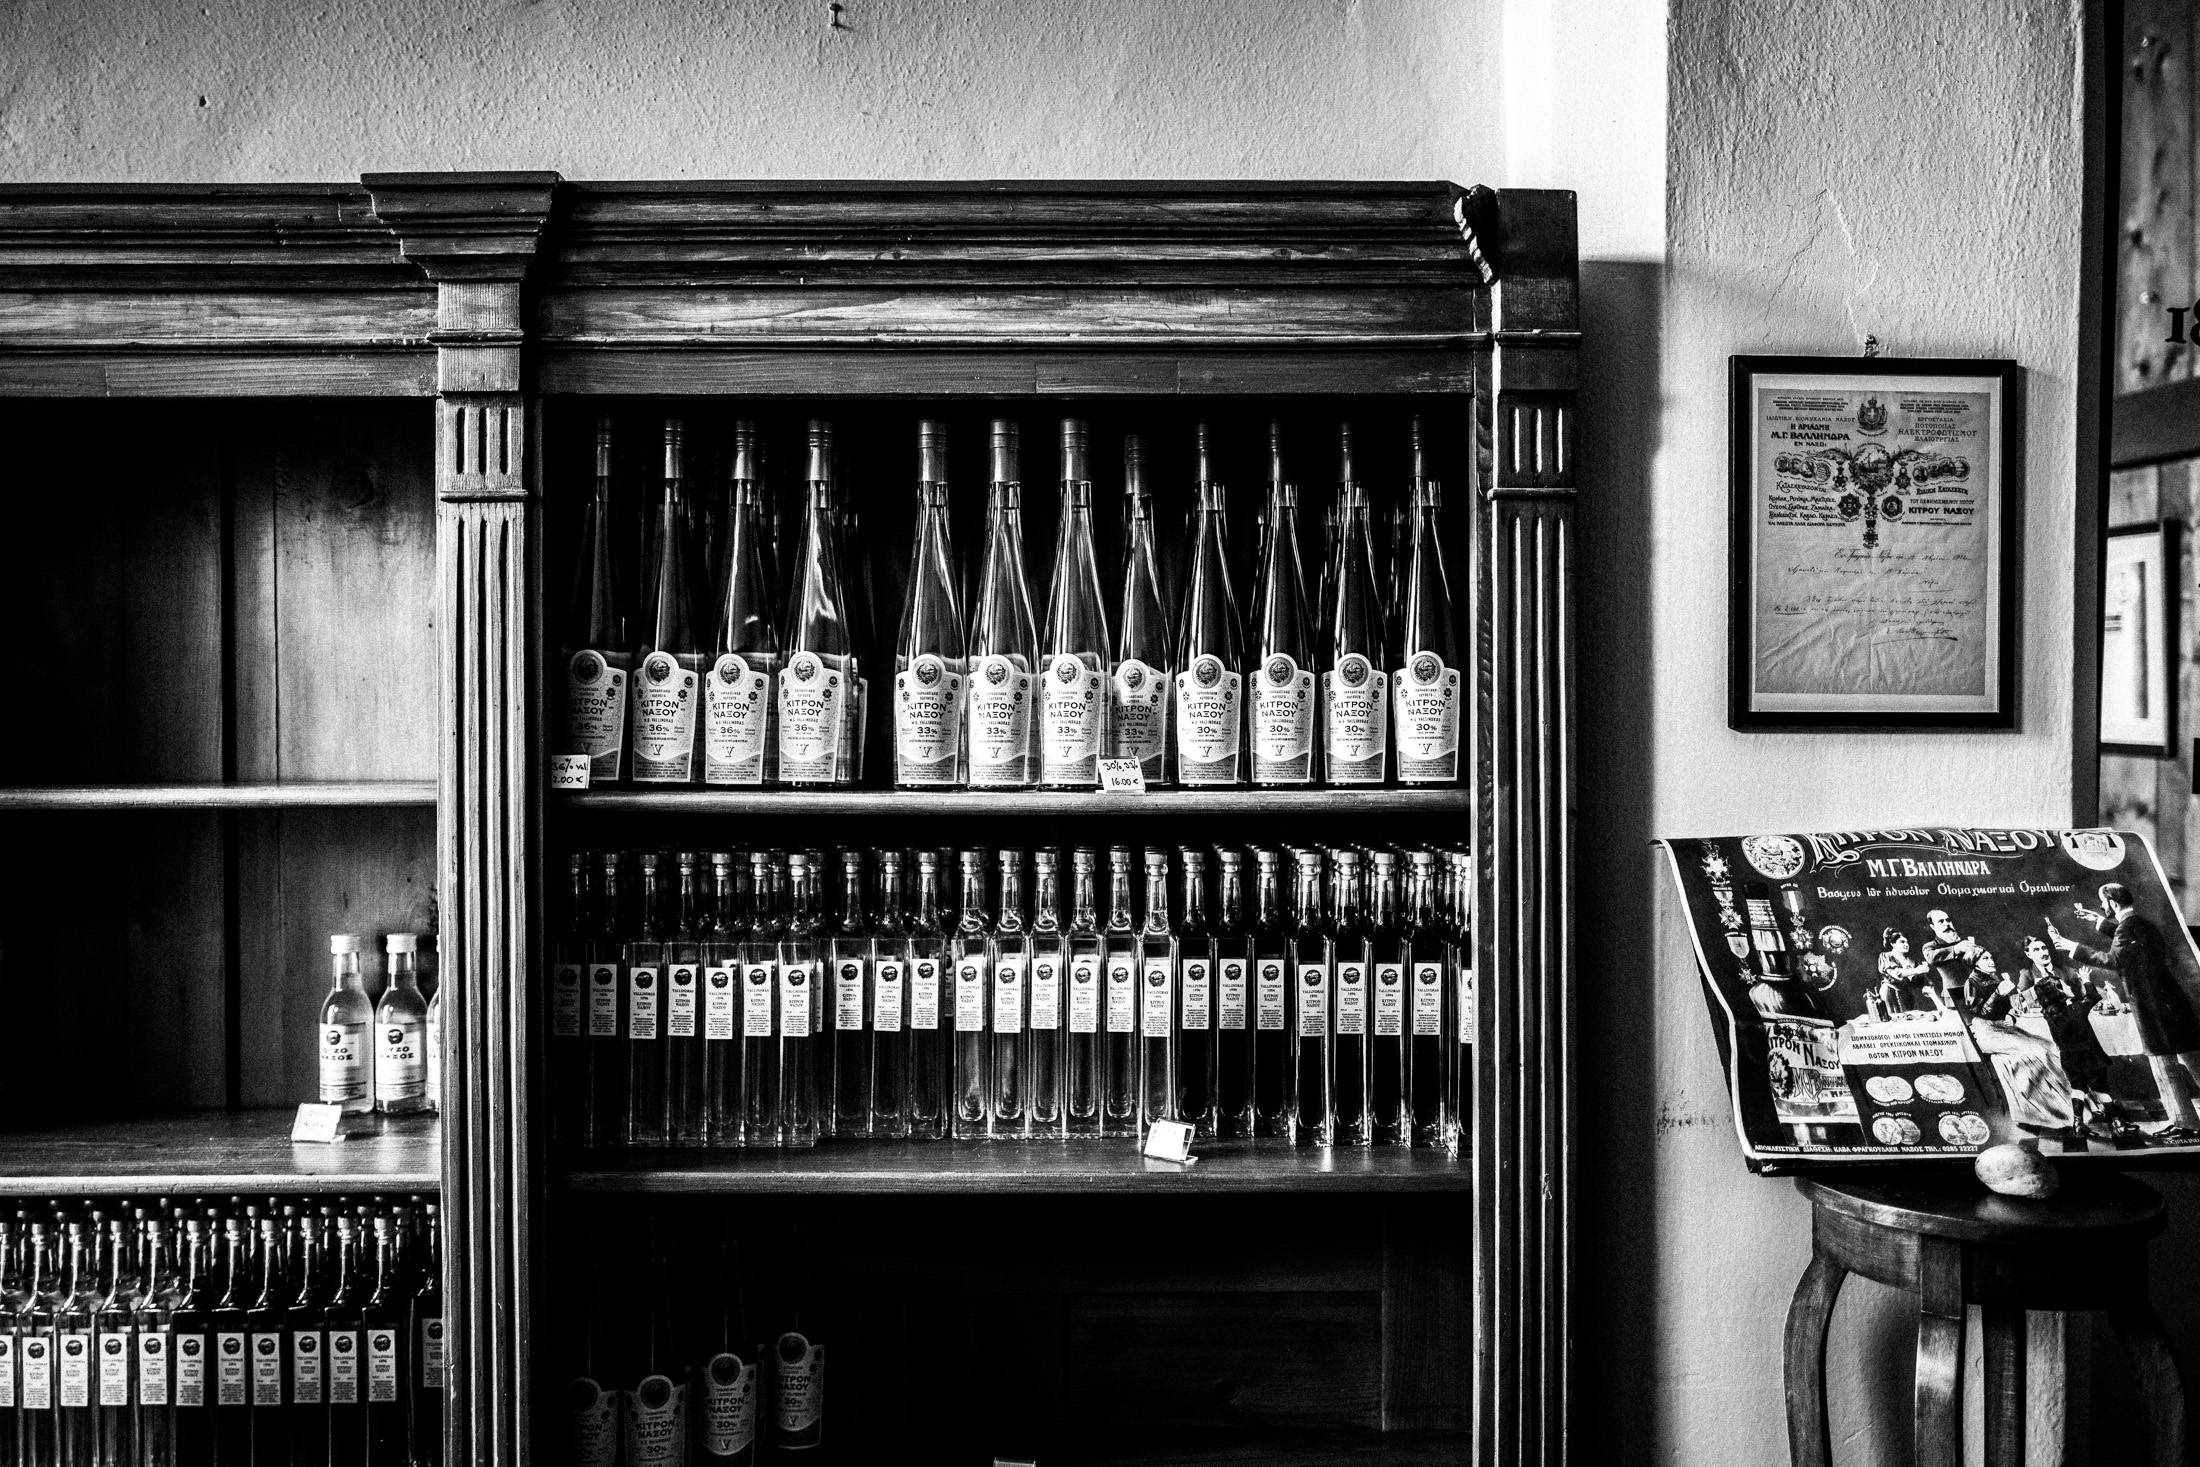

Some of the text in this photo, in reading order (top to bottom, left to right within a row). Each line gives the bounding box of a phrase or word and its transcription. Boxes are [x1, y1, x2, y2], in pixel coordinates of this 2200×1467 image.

[1797, 423, 1830, 431] ΑΡΙΑΔΝΗ
[1790, 431, 1851, 441] ΒΑΛΛΗΝΔΡΑ
[1943, 507, 1975, 515] ΝΑΞΟΥ
[640, 700, 680, 709] ΚΙΤΡΟΝ
[712, 702, 750, 711] ΚΙΤΡΟΝ
[786, 699, 825, 709] ΚΙΤΡΟΝ
[907, 702, 947, 711] ΚΙΤΡΟΝ
[977, 702, 1016, 711] ΚΙΤΡΟΝ
[1048, 701, 1087, 710] ΚΙΤΡΟΝ
[1187, 702, 1226, 711] ΚΙΤΡΟΝ
[1260, 701, 1299, 710] ΚΙΤΡΟΝ
[1333, 701, 1374, 710] ΚΙΤΡΟΝ
[1406, 699, 1446, 708] ΚΙΤΡΟΝ
[641, 708, 677, 717] ΝΑΞΟΥ
[787, 708, 822, 717] ΝΑΞΟΥ
[1115, 705, 1152, 713] ΚΙΤΡΟΝ
[1261, 709, 1297, 717] ΝΑΞΟΥ
[1336, 709, 1371, 718] ΝΑΞΟΥ
[1407, 707, 1443, 716] ΝΑΞΟΥ
[713, 710, 748, 719] ΝΑΞΟΥ
[909, 710, 945, 719] ΝΑΞΟΥ
[978, 711, 1013, 719] ΝΑΞΟΥ
[1050, 710, 1084, 718] ΝΑΞΟΥ
[1116, 713, 1150, 721] ΝΑΞΟΥ
[1189, 710, 1224, 718] ΝΑΞΟΥ
[648, 724, 670, 732] 36%
[720, 726, 741, 734] 36%
[794, 723, 815, 732] 36%
[917, 726, 939, 734] 33%
[986, 727, 1007, 735] 33%
[1057, 726, 1078, 734] 33%
[1197, 726, 1218, 734] 30%
[1269, 725, 1290, 733] 30%
[1344, 725, 1366, 733] 30%
[1416, 723, 1438, 731] 30%
[1124, 728, 1145, 736] 33%
[1769, 1036, 1801, 1055] ΙΤΡΟΝ
[1892, 1049, 1917, 1058] ΚΙΤΡΟΝ
[1918, 1048, 1944, 1057] ΝΑΞΟΥ
[707, 1398, 745, 1406] ΚΙΤΡΟΝ
[709, 1405, 742, 1414] ΝΑΞΟΥ
[636, 1420, 675, 1431] ΚΙΤΡΟΝ
[638, 1428, 673, 1439] ΝΑΞΟΥ
